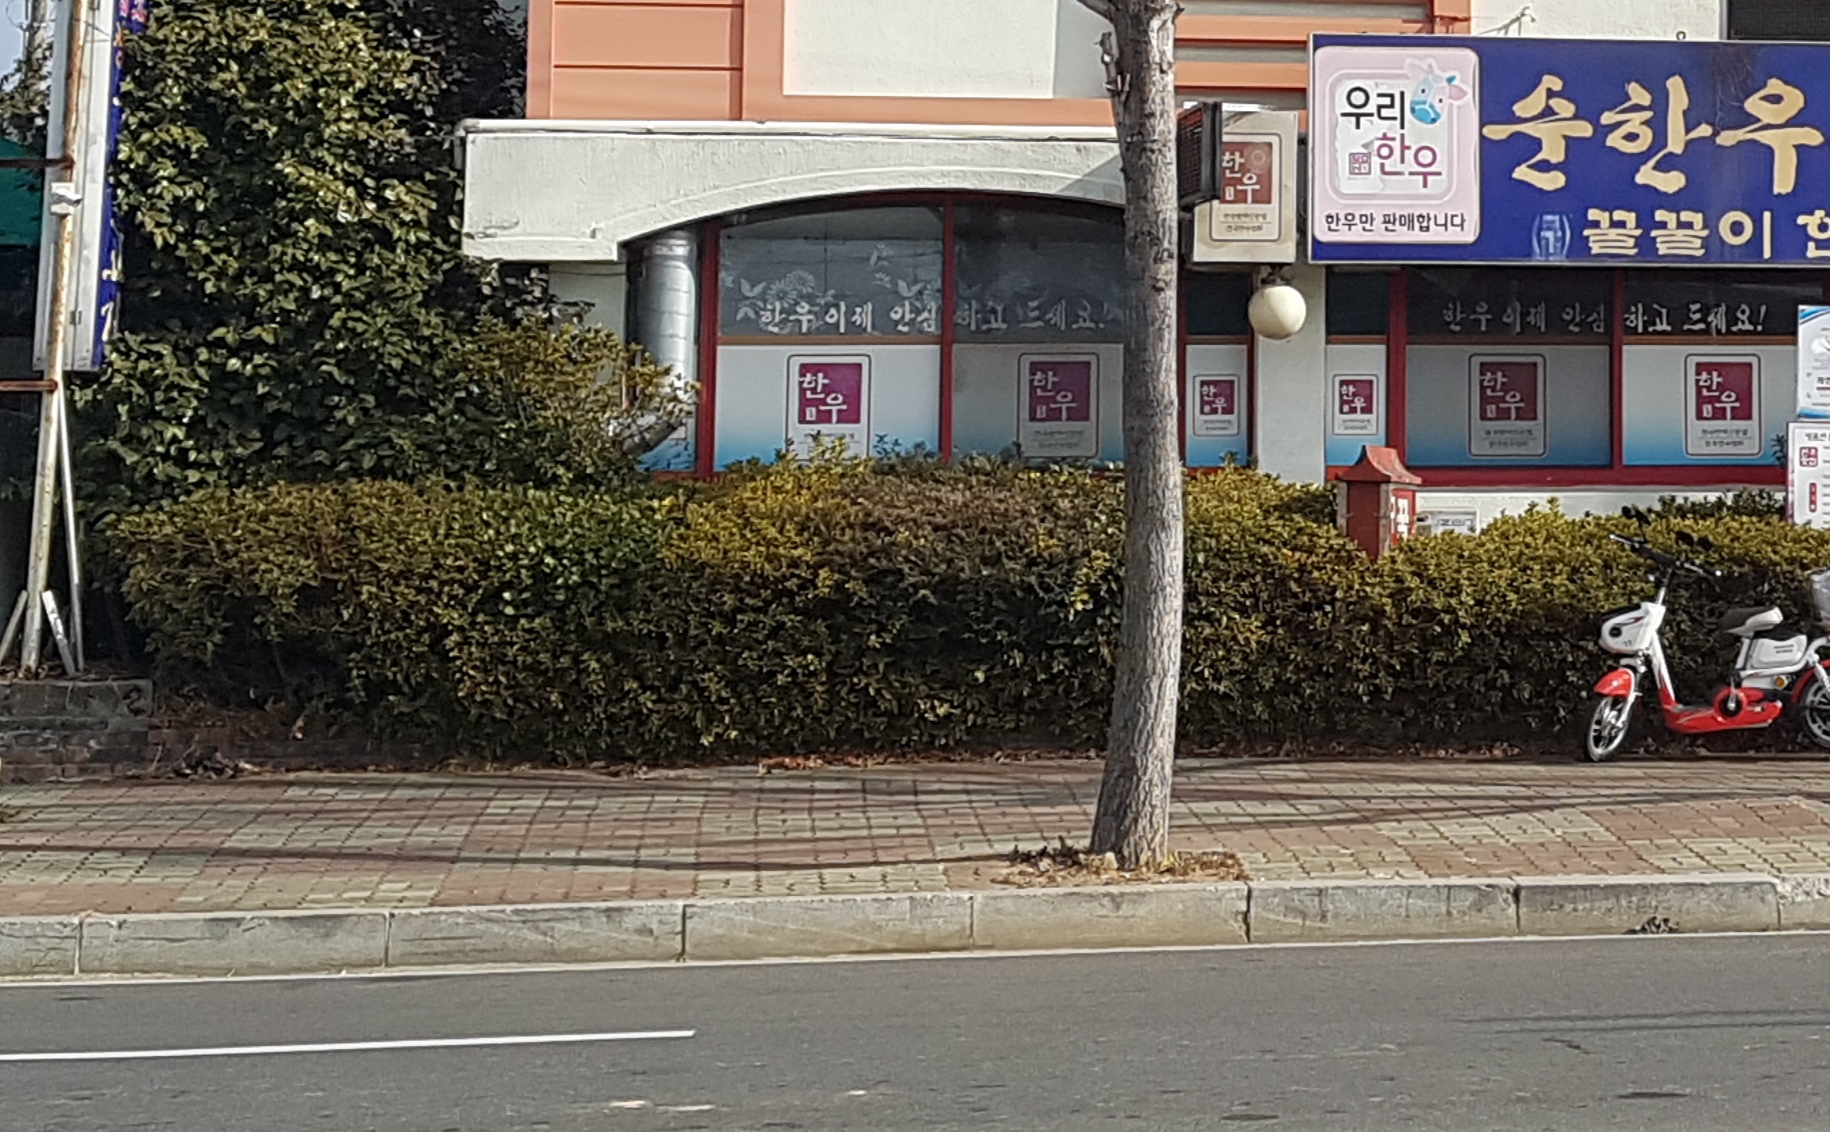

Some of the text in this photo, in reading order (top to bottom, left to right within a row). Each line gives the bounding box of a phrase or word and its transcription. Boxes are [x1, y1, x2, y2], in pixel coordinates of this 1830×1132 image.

[1340, 86, 1405, 130] 우리
[1222, 150, 1261, 205] 한우
[1375, 132, 1443, 189] 한우
[1325, 211, 1467, 233] 한우만 판매합니다
[1683, 301, 1767, 336] 드세요!
[798, 371, 848, 425] 한우
[1029, 369, 1077, 423] 한우
[1479, 370, 1525, 420] 한우
[1695, 369, 1741, 420] 한우
